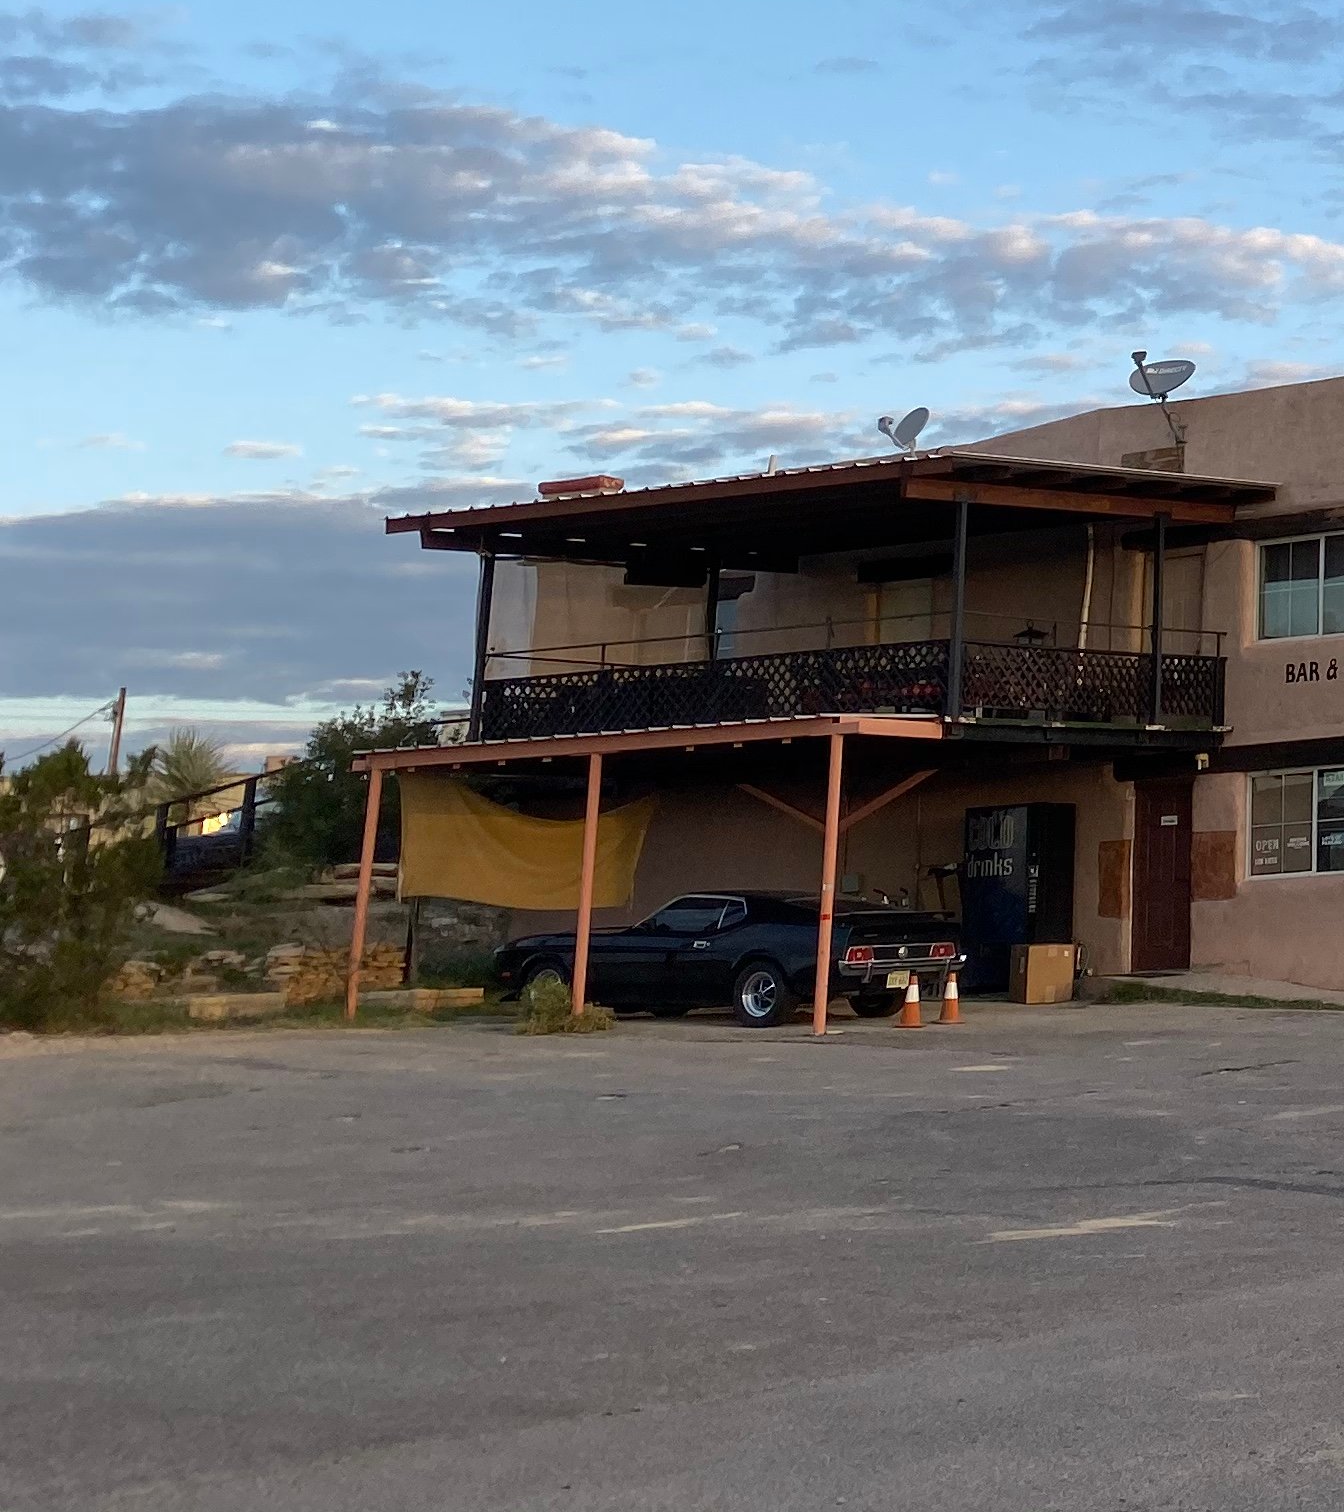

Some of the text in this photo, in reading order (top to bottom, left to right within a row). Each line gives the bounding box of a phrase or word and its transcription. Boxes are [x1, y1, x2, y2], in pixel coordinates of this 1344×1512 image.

[1285, 662, 1320, 683] BAR
[1326, 658, 1338, 680] &
[1255, 839, 1279, 852] OPEN
[967, 852, 1013, 877] drinks
